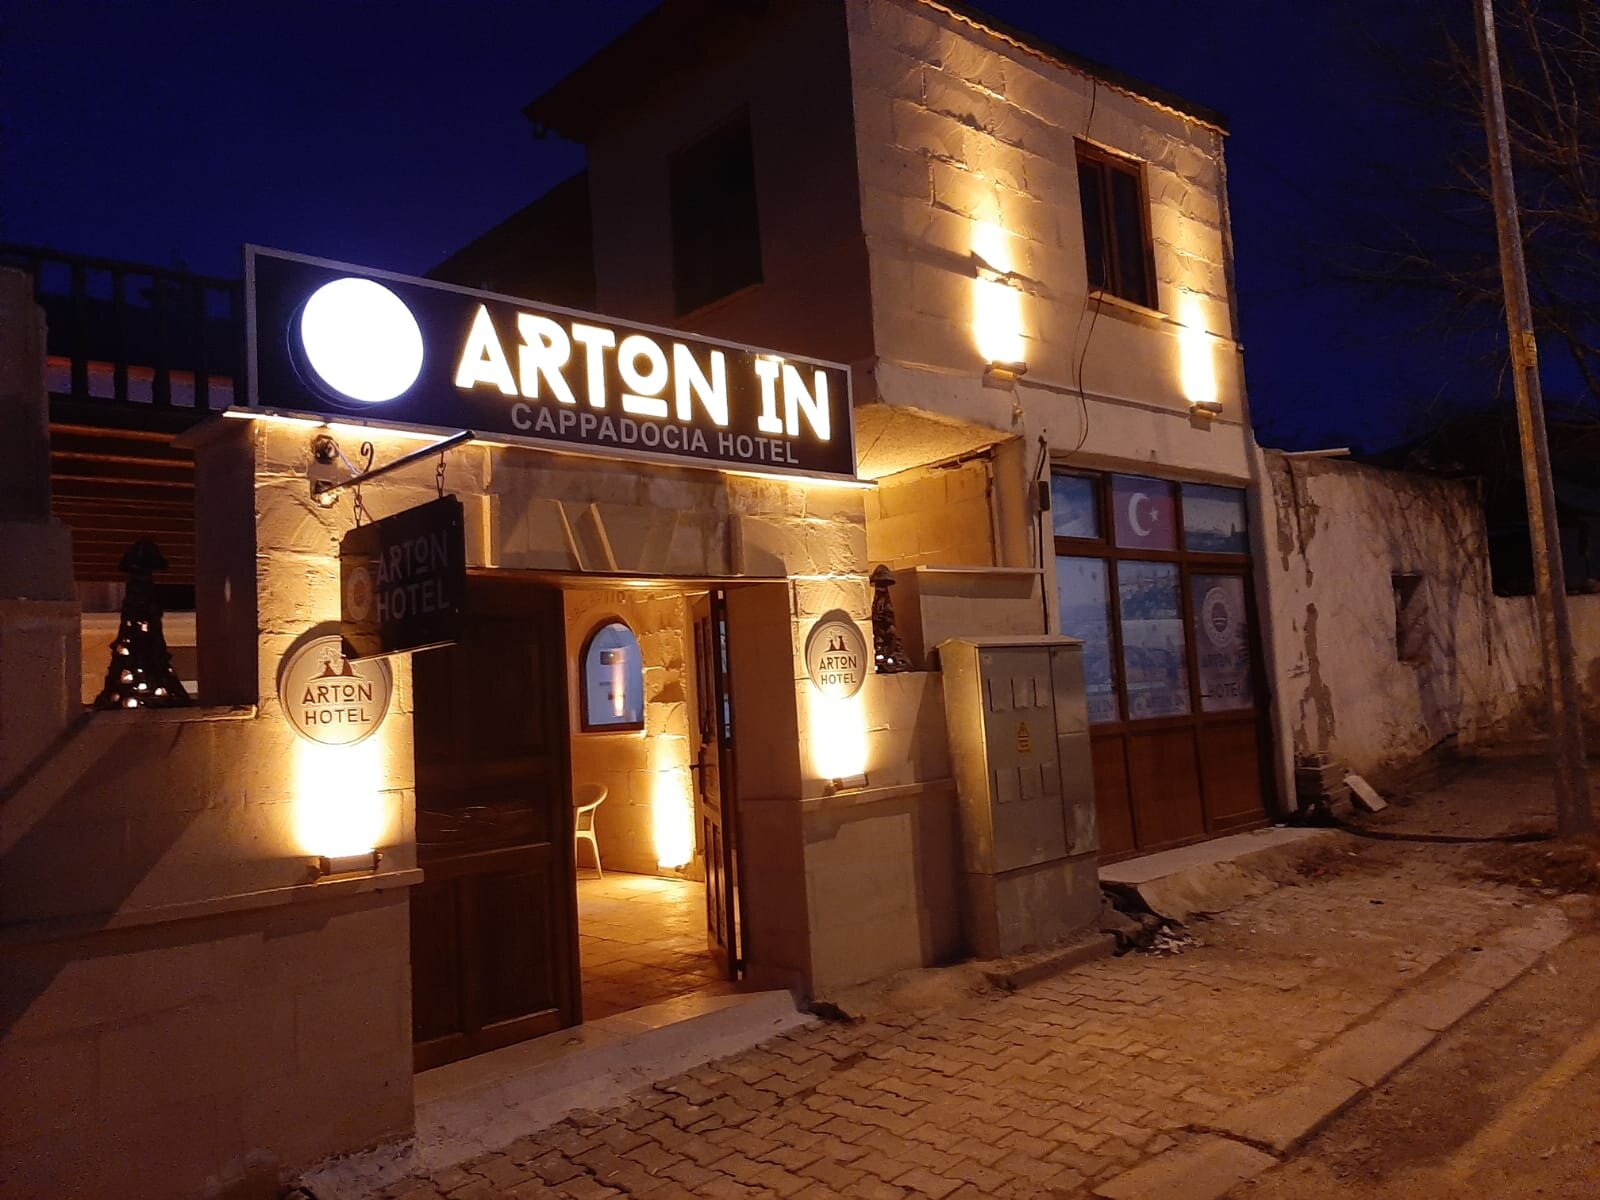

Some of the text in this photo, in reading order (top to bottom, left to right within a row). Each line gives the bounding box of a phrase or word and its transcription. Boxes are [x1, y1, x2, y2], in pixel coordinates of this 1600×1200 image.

[455, 303, 831, 440] ARTON IN
[511, 402, 799, 464] CAPPADOCIA HOTEL
[376, 530, 449, 586] ARTON
[376, 577, 450, 623] HOTEL
[819, 656, 857, 670] ARTON
[821, 673, 856, 685] HOTEL
[302, 684, 373, 704] ARTON
[305, 708, 371, 726] HOTEL
